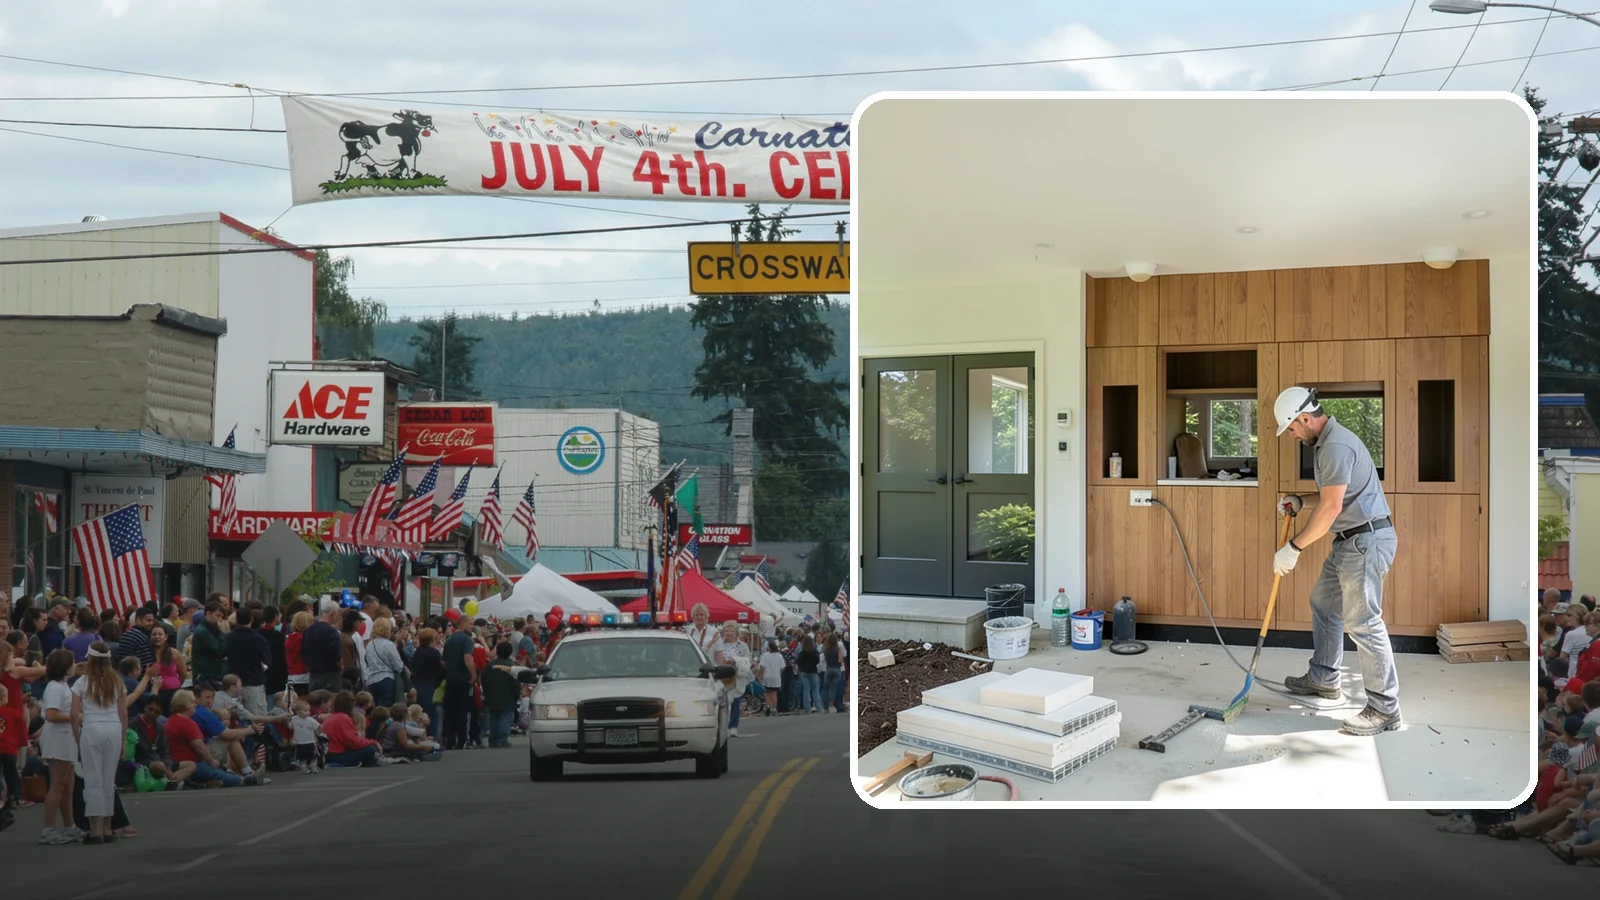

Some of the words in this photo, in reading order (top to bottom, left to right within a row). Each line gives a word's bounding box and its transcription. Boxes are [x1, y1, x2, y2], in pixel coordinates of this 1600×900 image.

[695, 122, 850, 149] Carnat
[481, 140, 605, 192] JULY
[632, 150, 746, 198] 4th.
[697, 254, 850, 280] CROSSWA
[283, 380, 373, 420] ACE
[406, 409, 452, 422] CEDAR
[283, 421, 371, 436] Hardware
[416, 428, 477, 447] Coca-Cola
[95, 485, 124, 495] Vincent
[126, 485, 135, 494] de
[138, 486, 155, 495] Paul
[212, 516, 331, 535] HARDARE
[688, 526, 741, 535] CRNATION
